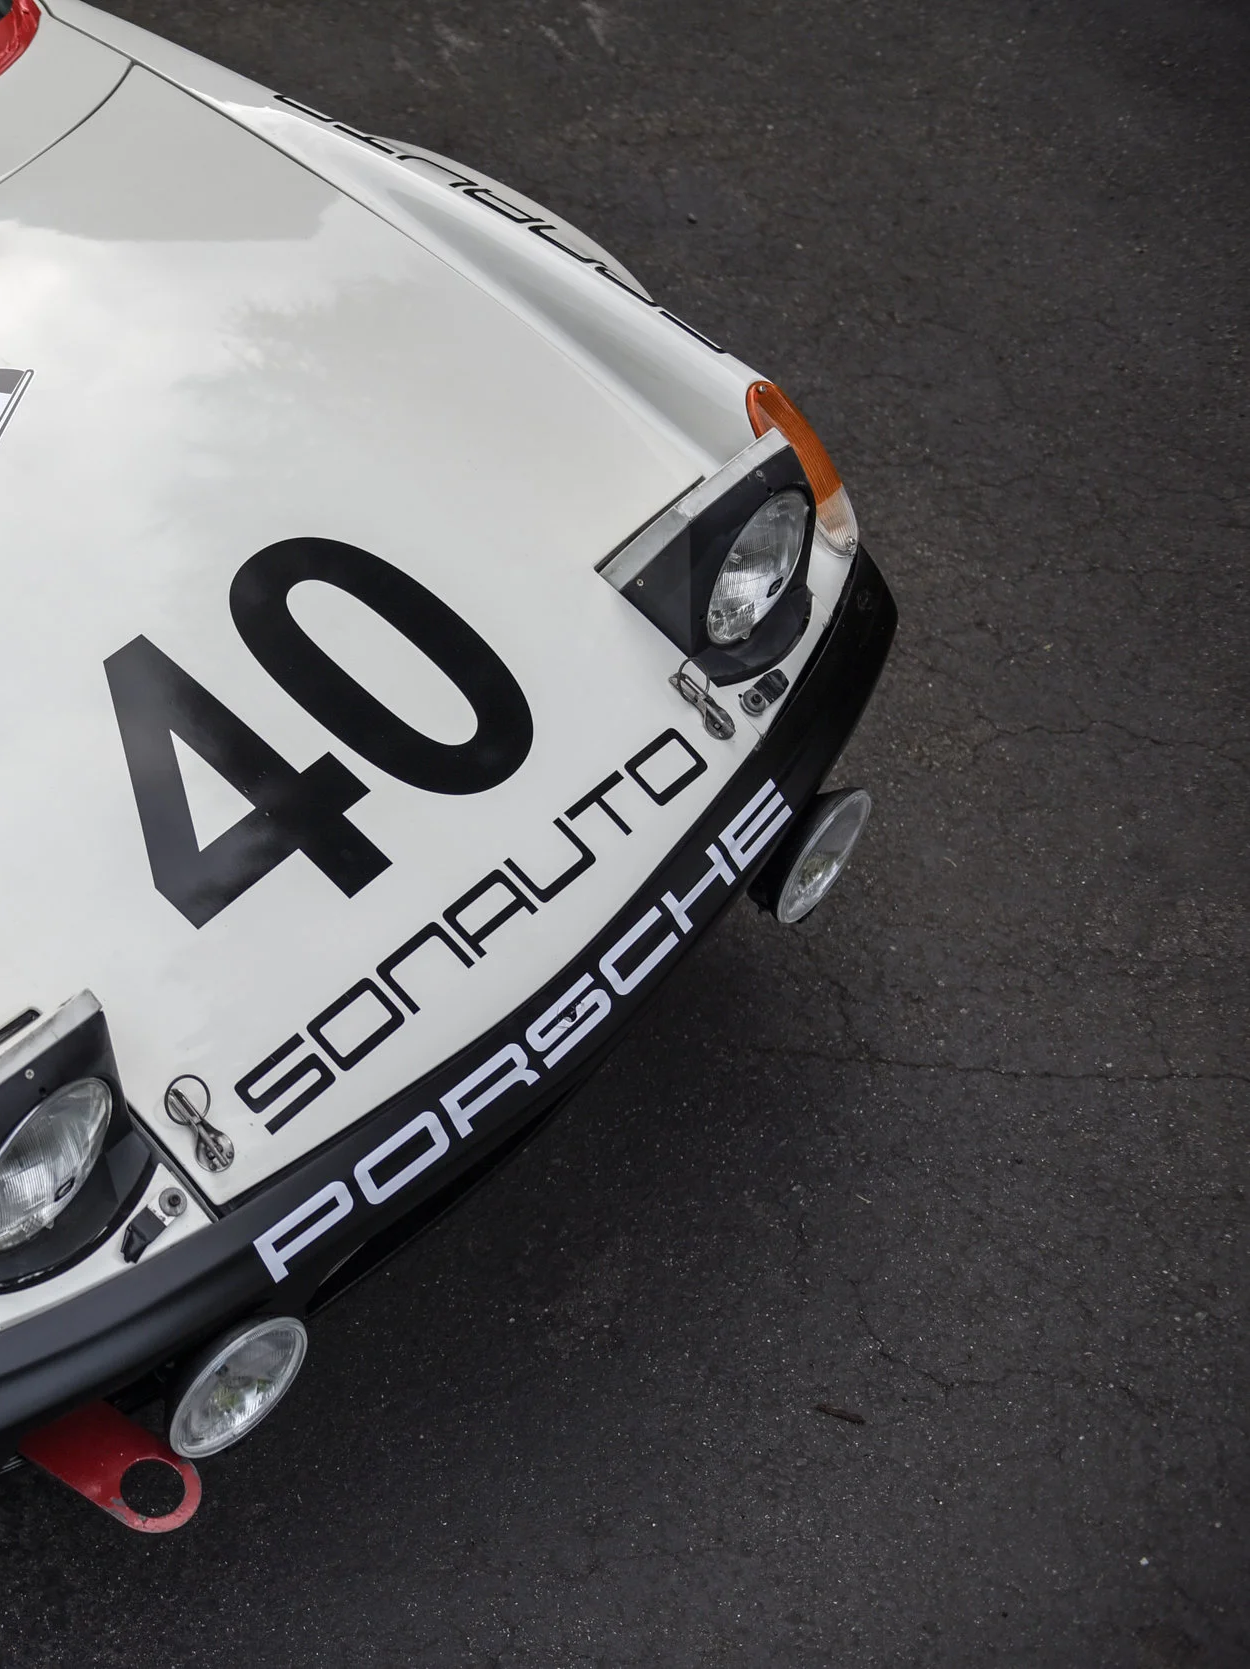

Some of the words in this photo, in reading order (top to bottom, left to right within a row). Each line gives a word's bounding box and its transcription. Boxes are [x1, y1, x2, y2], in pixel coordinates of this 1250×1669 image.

[102, 537, 534, 930] 40
[234, 728, 708, 1136] SONAUTO
[253, 778, 793, 1284] PORSCHE
